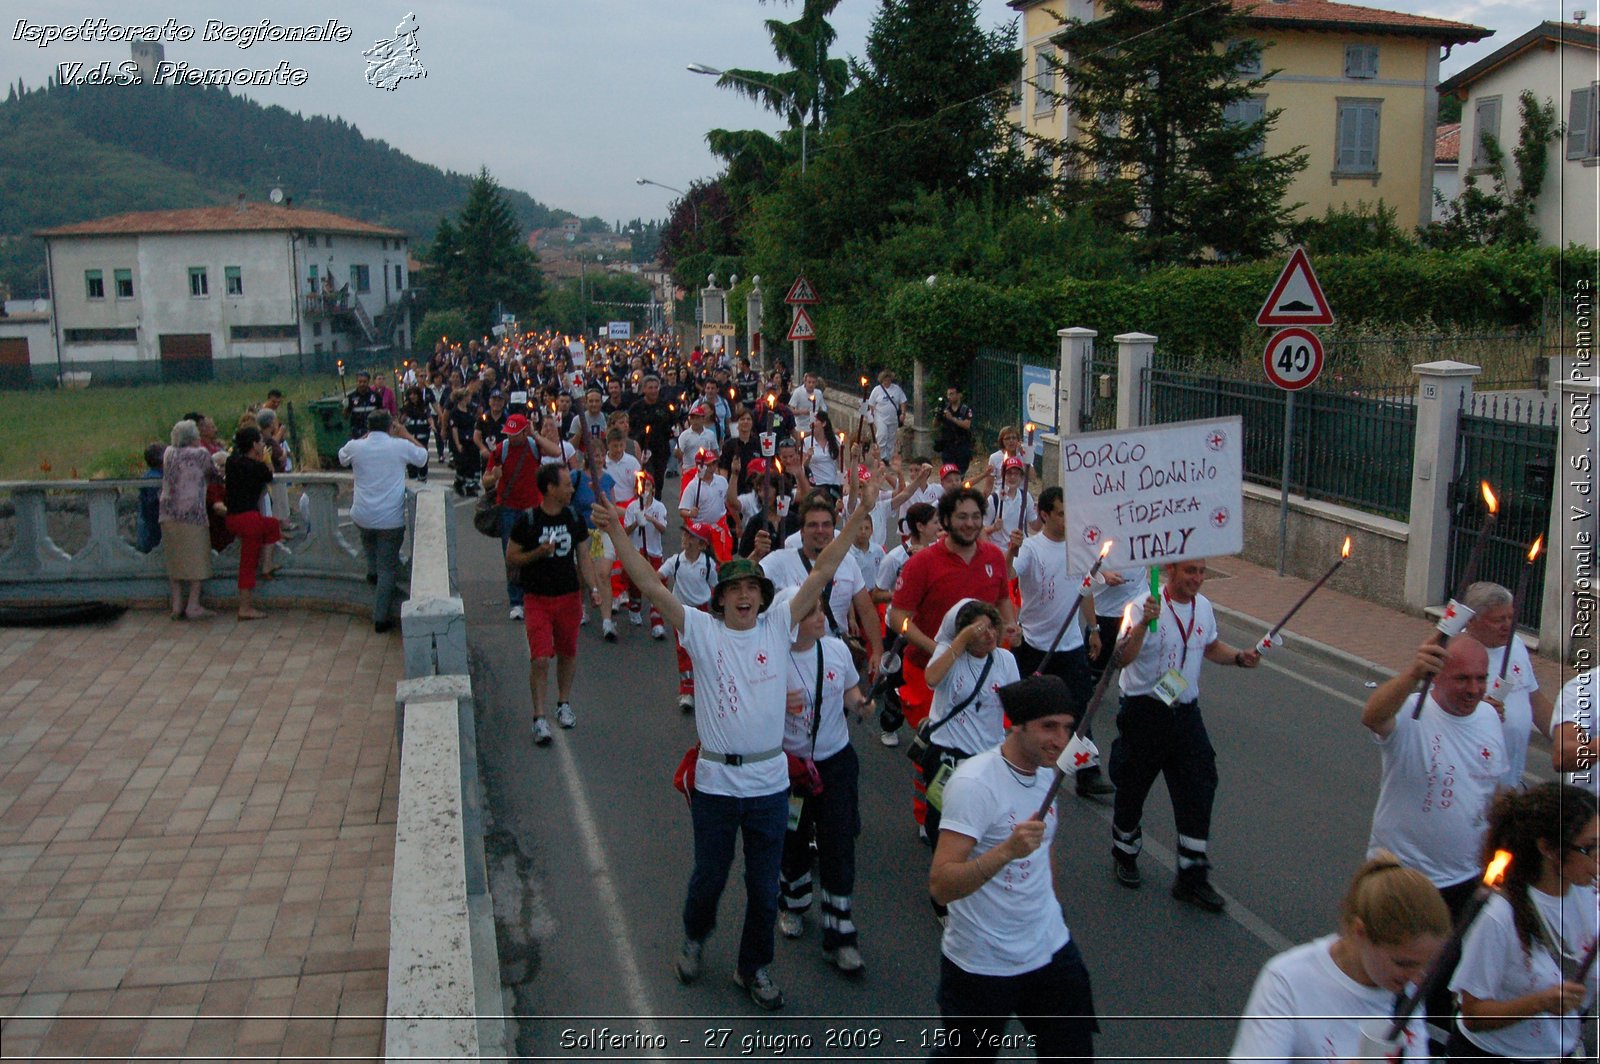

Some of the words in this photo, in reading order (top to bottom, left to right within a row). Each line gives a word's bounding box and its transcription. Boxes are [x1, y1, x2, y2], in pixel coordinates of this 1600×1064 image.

[1277, 345, 1310, 373] 40
[1426, 387, 1434, 396] 15
[1065, 441, 1146, 472] BORGO
[1093, 470, 1126, 496] SAN
[1129, 527, 1197, 560] ITALY
